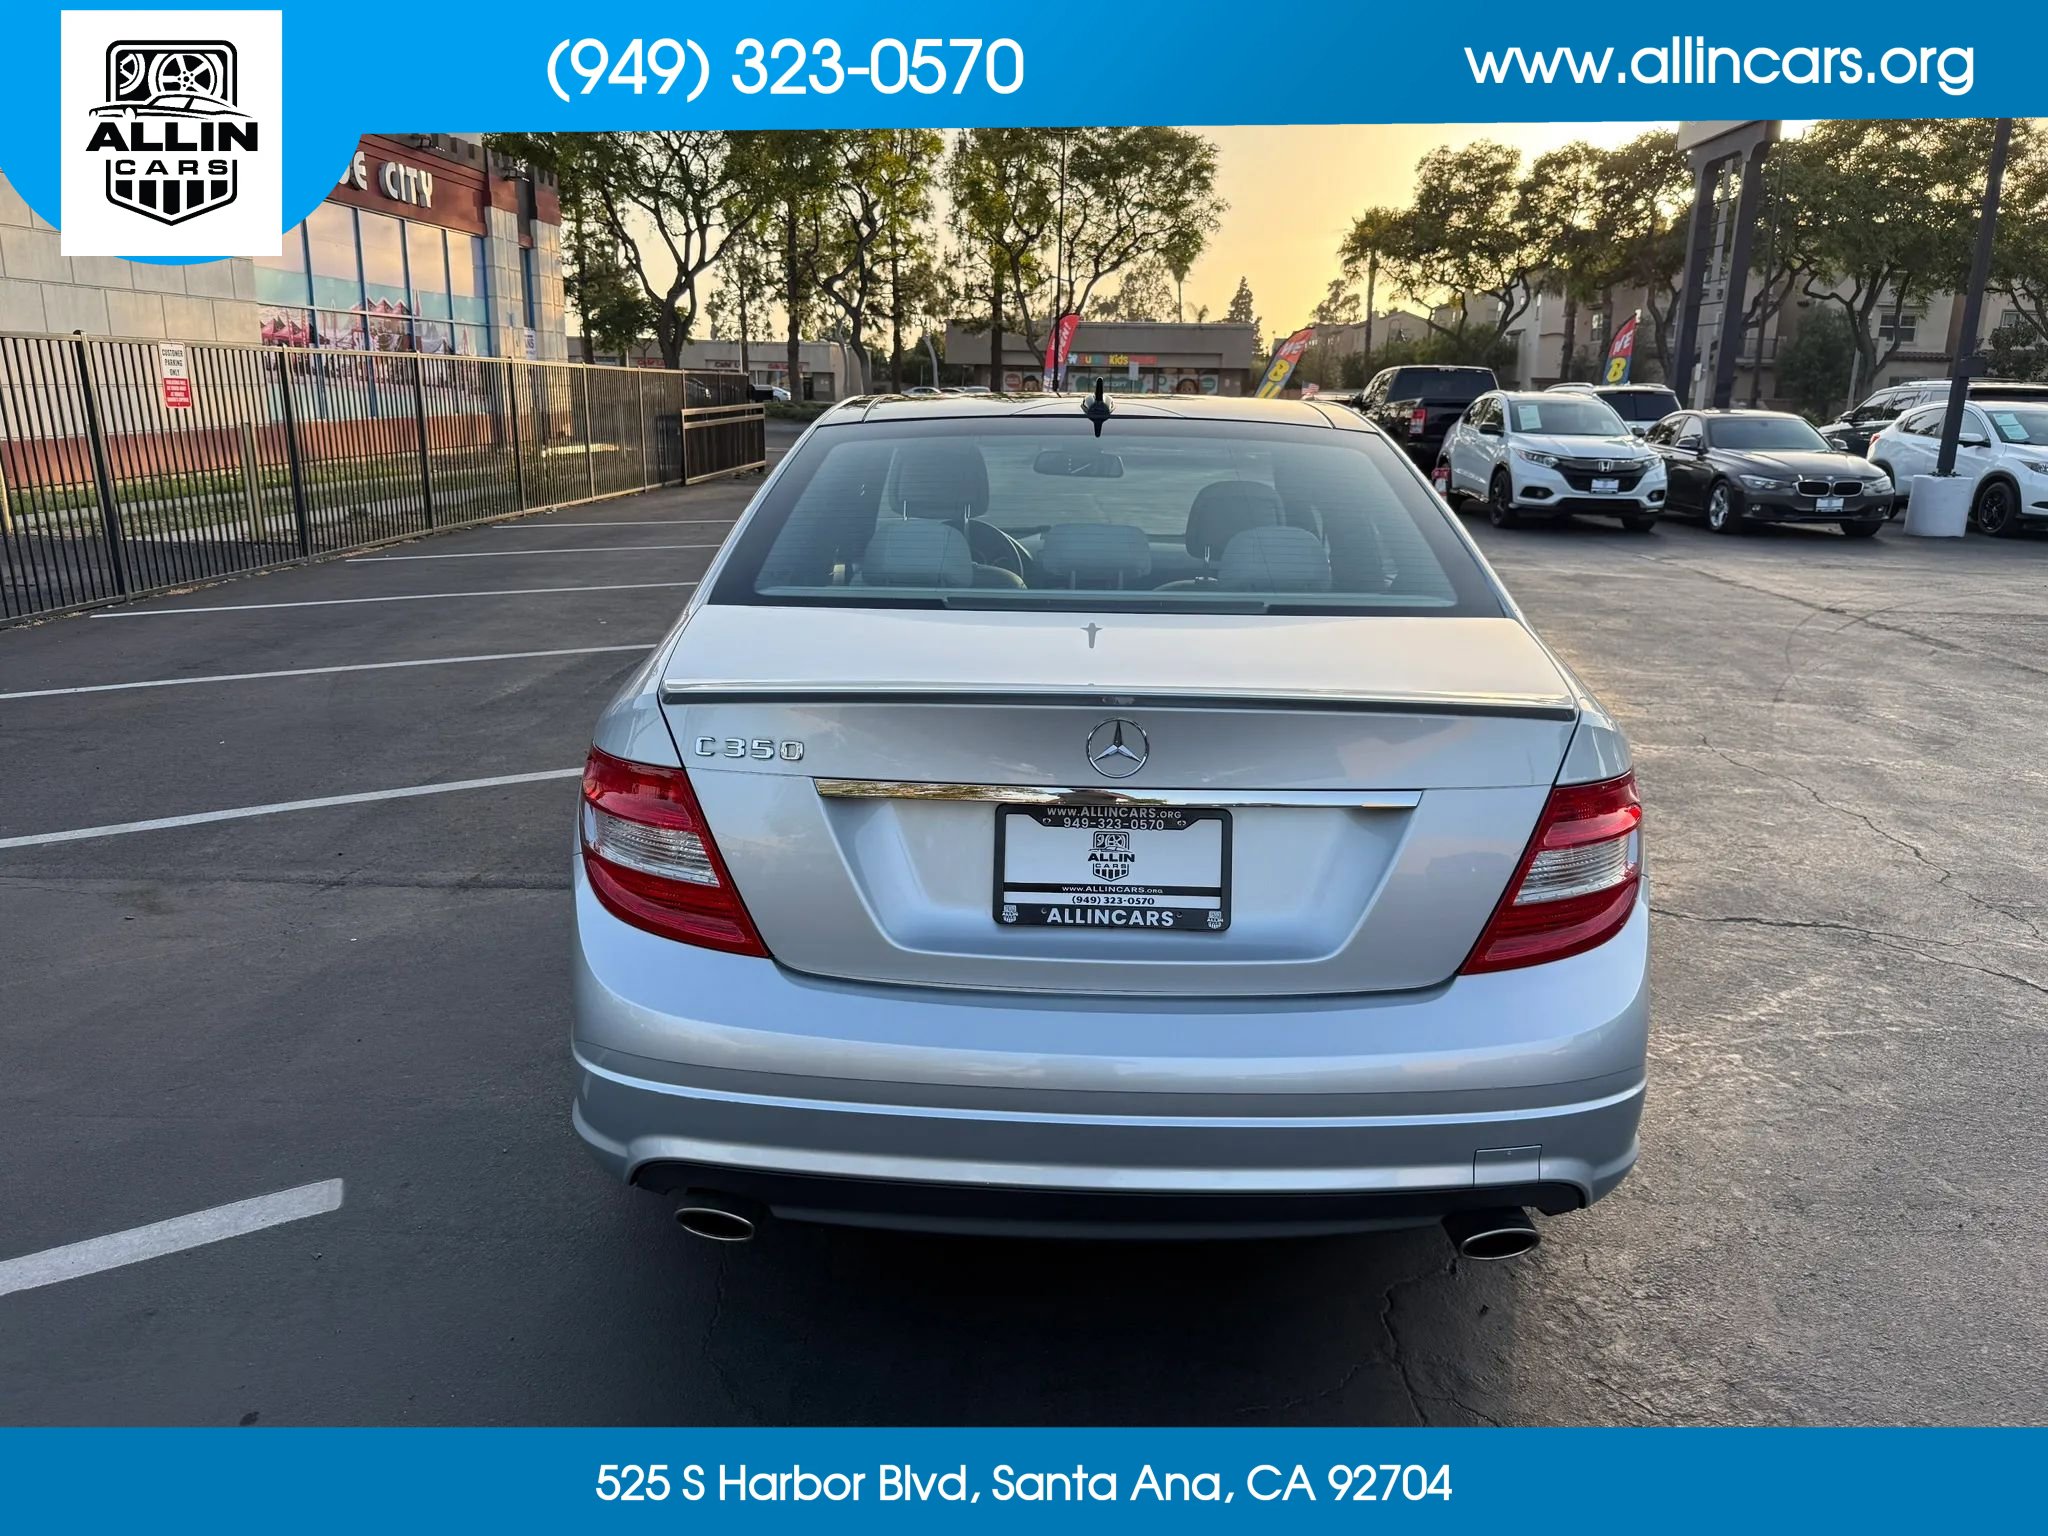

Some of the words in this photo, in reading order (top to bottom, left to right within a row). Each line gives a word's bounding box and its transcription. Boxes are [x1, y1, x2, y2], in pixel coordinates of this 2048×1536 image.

[380, 161, 433, 208] CITY
[1063, 817, 1165, 831] 949-323-0570
[1087, 853, 1136, 863] ALLIN
[1071, 895, 1101, 905] (949)
[1103, 896, 1156, 906] 323-0570
[1046, 907, 1175, 927] ALLINCARS
